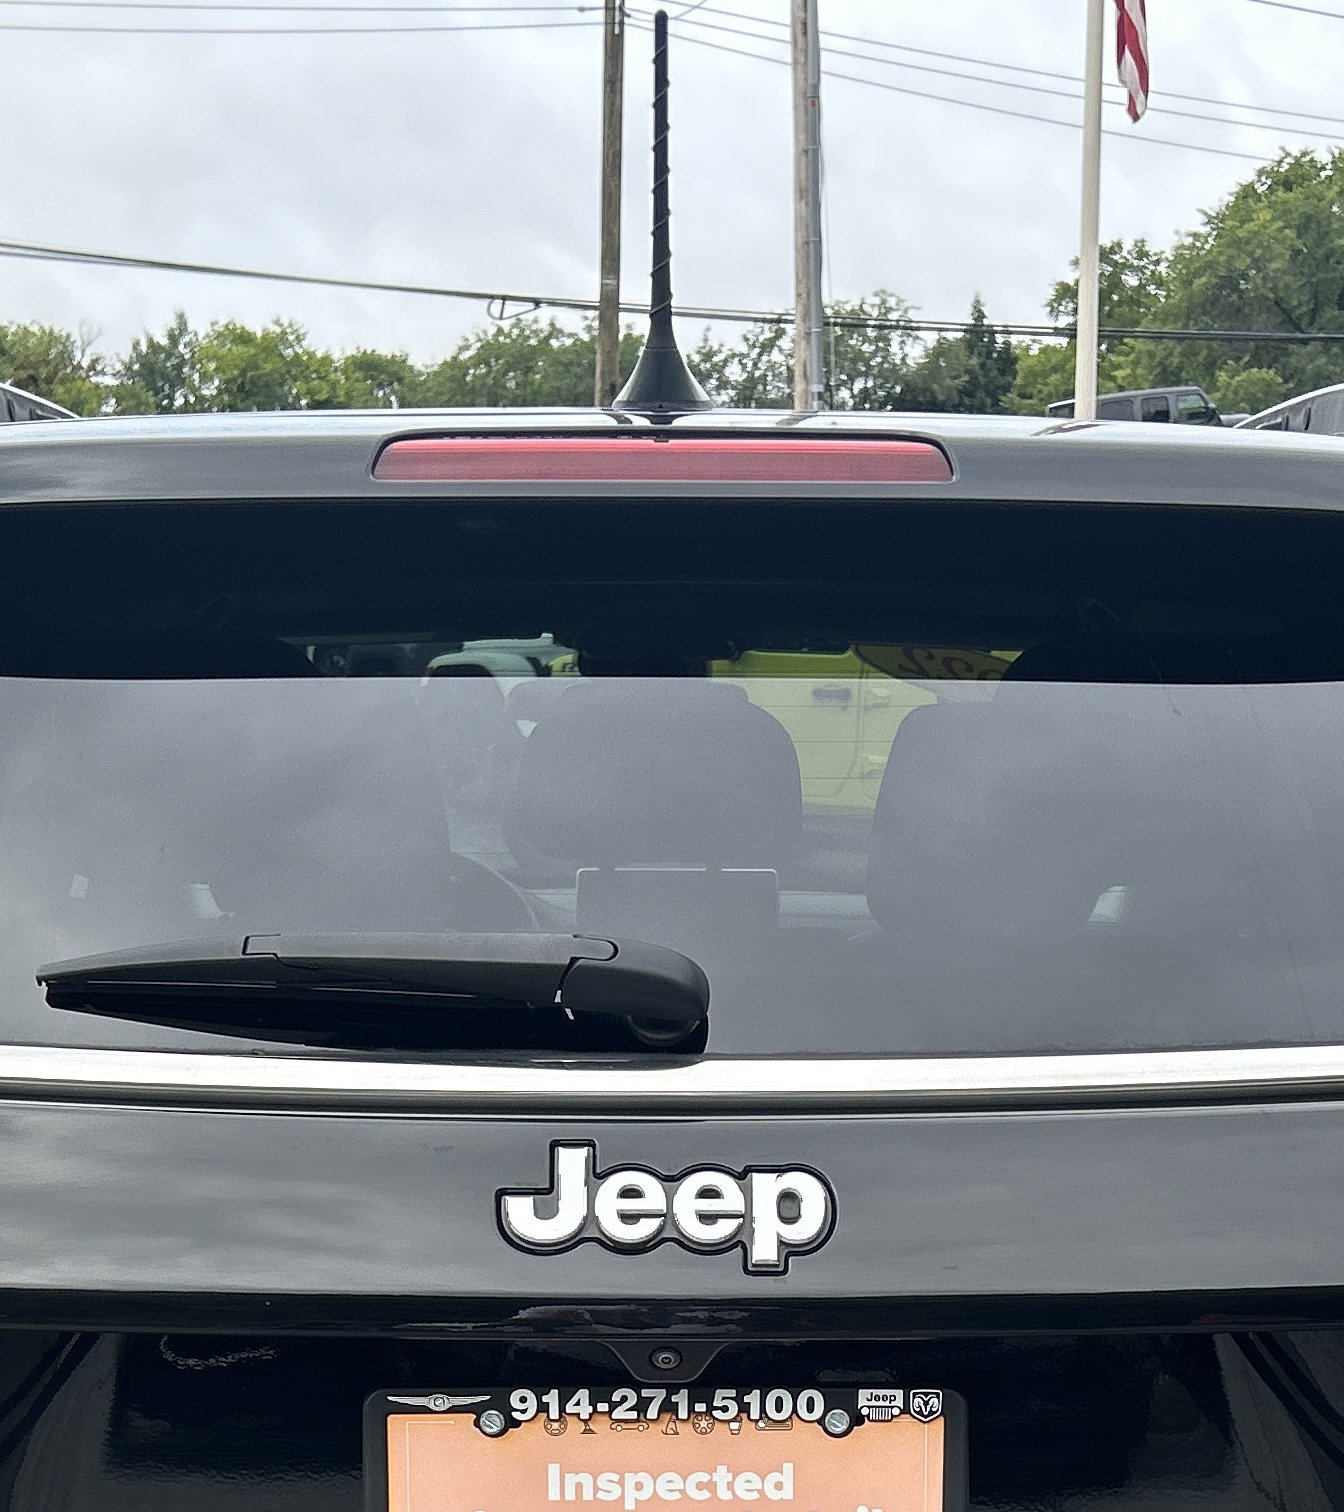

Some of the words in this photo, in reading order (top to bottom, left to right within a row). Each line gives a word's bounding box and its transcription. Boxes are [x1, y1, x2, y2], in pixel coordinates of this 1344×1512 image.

[500, 1144, 830, 1269] Jeep
[509, 1388, 825, 1421] 914-271-5100
[865, 1391, 897, 1405] Jeep
[547, 1462, 795, 1510] Inspected
